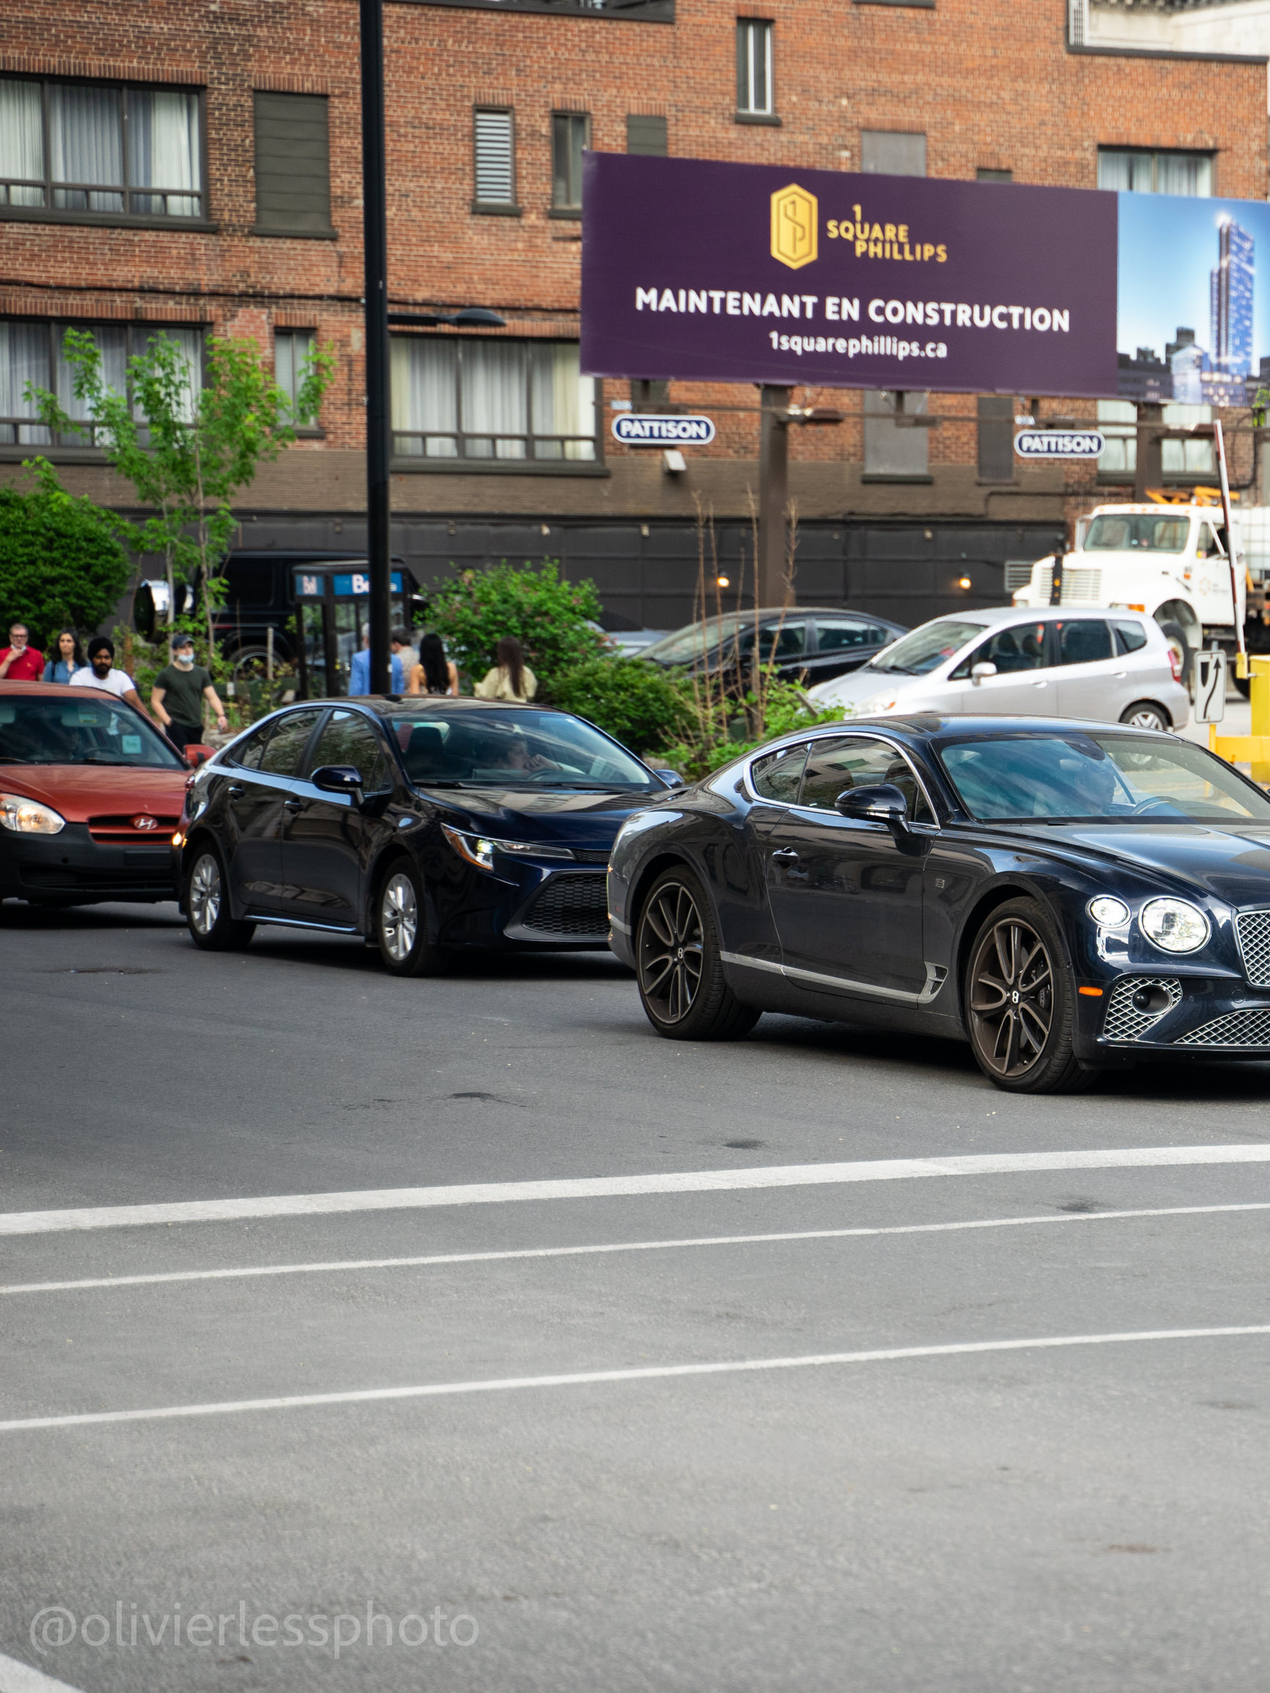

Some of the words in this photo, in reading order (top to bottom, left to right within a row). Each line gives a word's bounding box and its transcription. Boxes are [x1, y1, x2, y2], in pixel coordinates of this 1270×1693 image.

[852, 203, 863, 222] 1
[826, 219, 909, 242] SQUARE
[855, 239, 947, 263] PHILLIPS
[635, 286, 818, 320] MAINTENANT
[825, 296, 860, 321] EN
[868, 298, 1070, 333] CONSTRUCTION
[769, 330, 948, 360] 1squarephillips.ca
[619, 419, 708, 438] PATTISON
[1021, 435, 1099, 452] PATTISON
